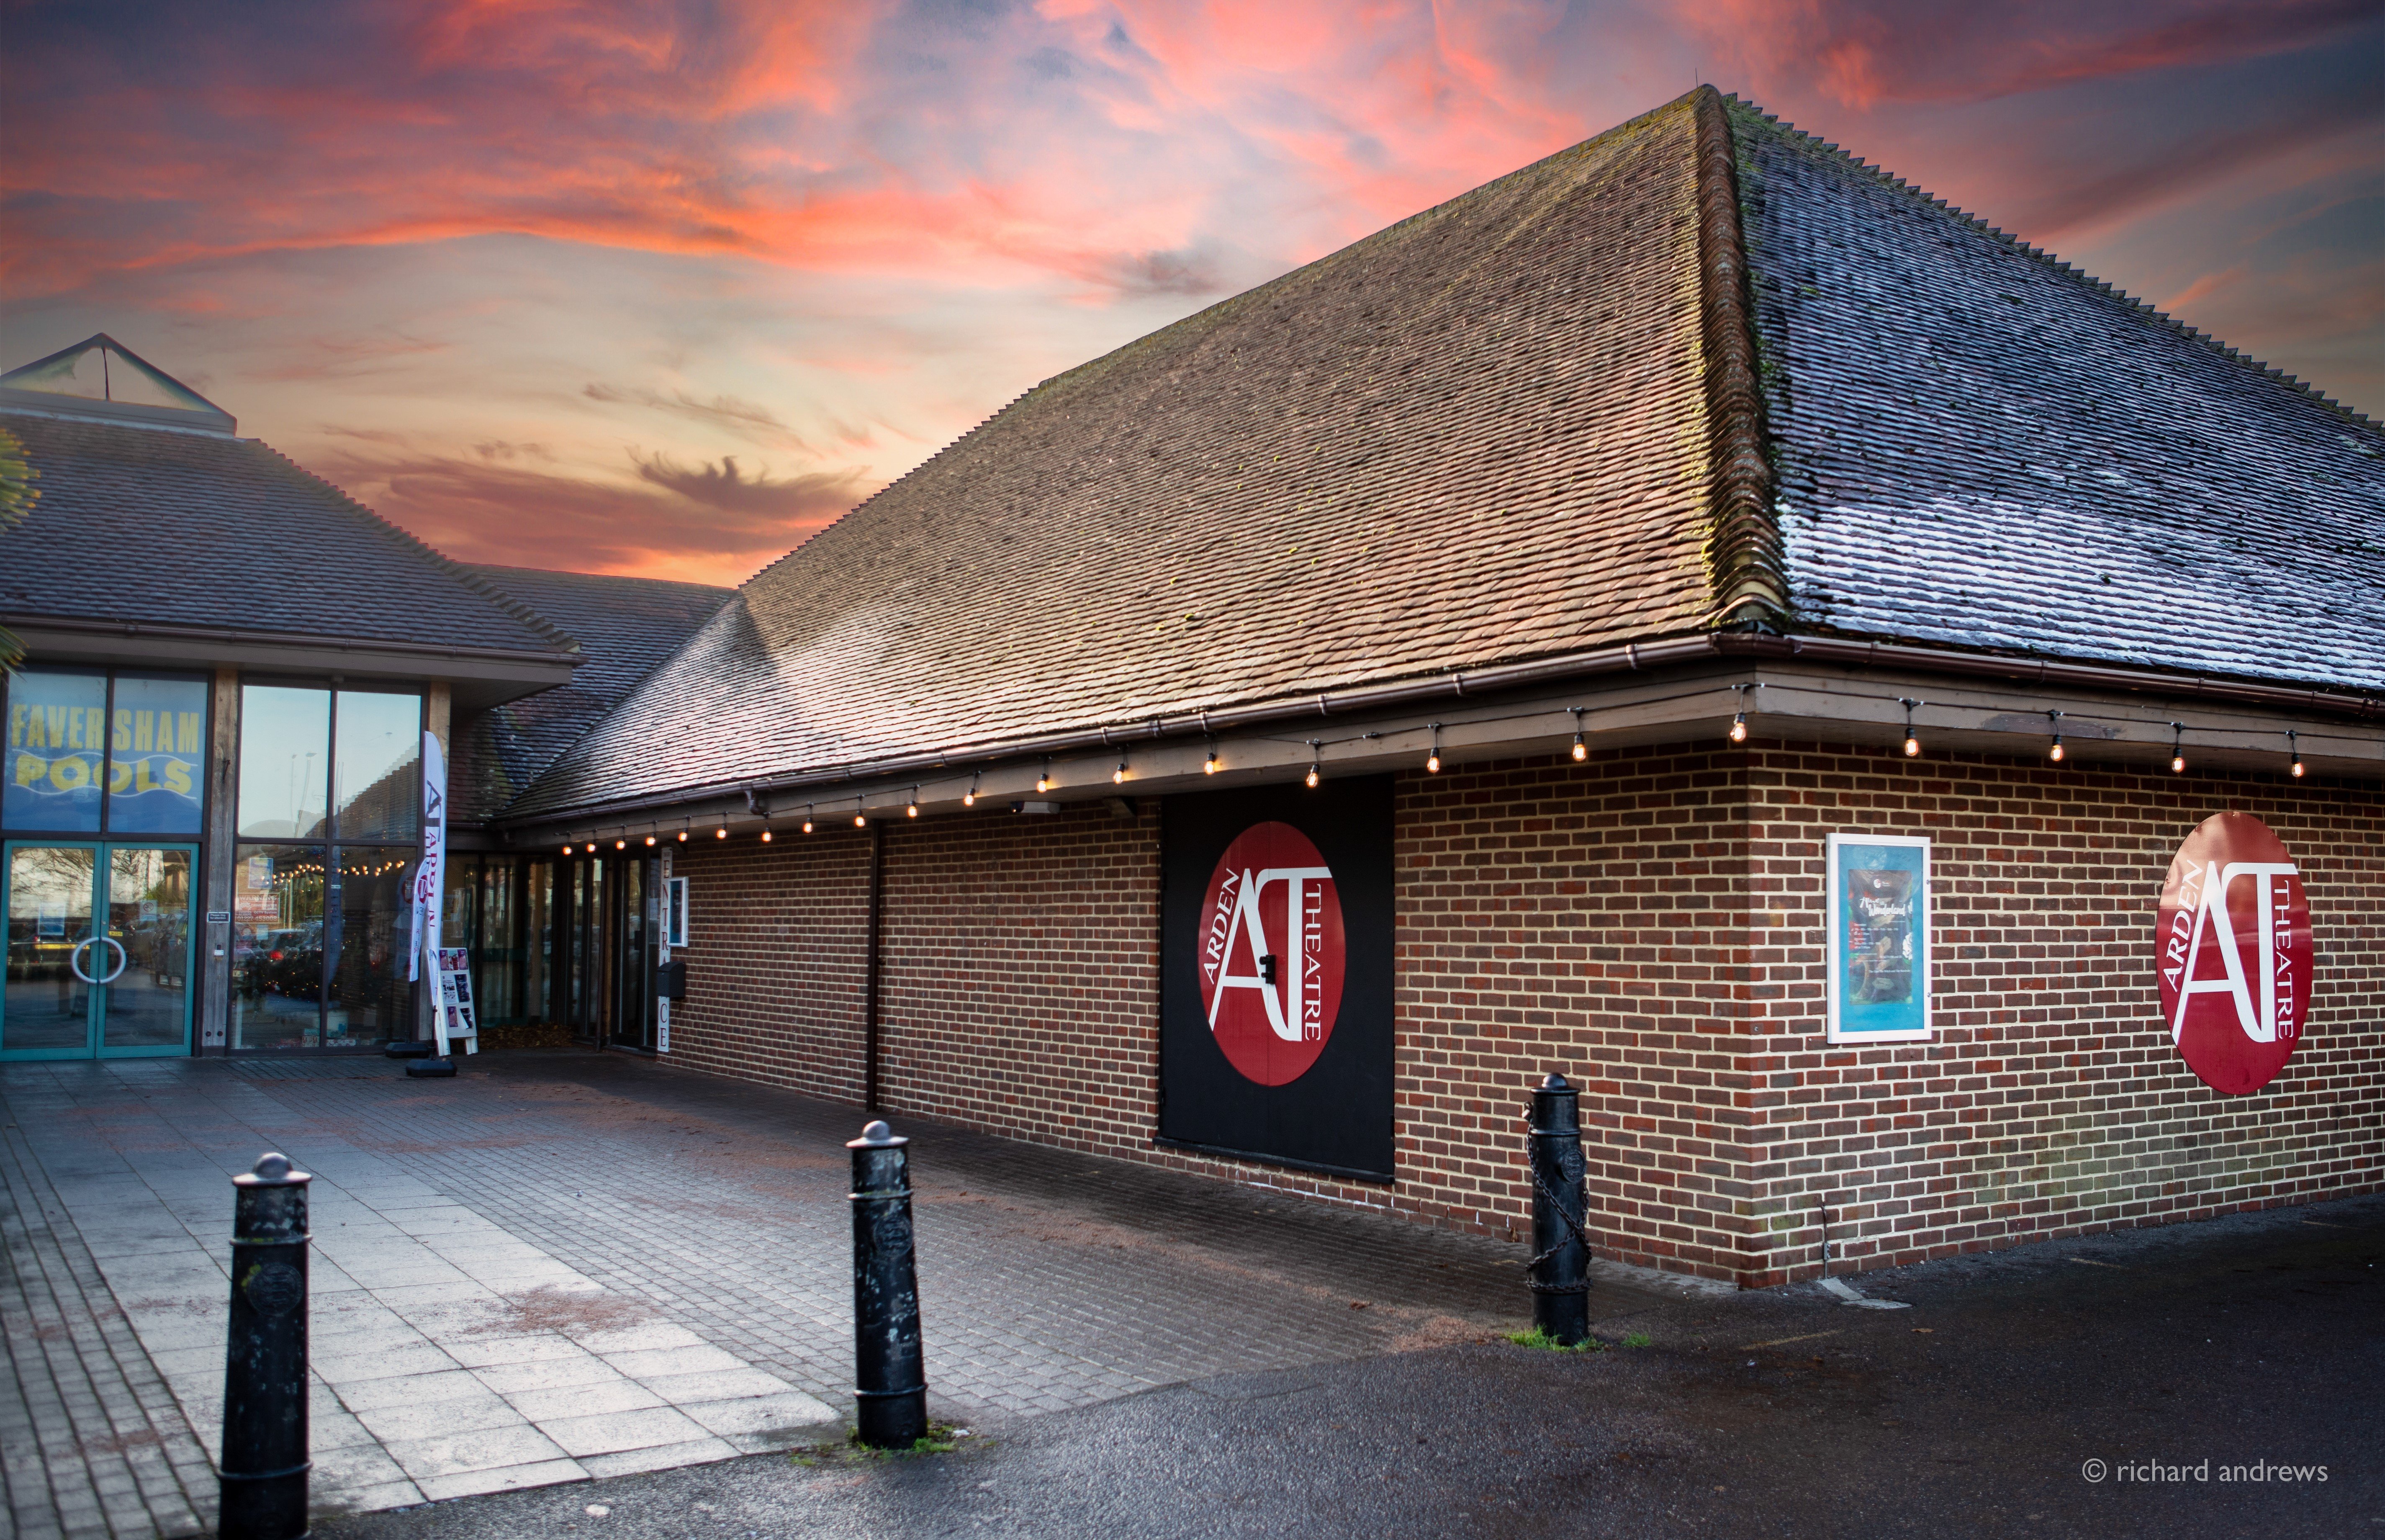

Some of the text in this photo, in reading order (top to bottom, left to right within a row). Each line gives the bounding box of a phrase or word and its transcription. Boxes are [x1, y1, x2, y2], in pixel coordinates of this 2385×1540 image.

[11, 704, 200, 753] FAVERSHAM
[15, 754, 192, 795] POOLS
[660, 860, 670, 1047] ENTRCE
[1203, 868, 1239, 985] ARDEN
[1305, 884, 1321, 1041] THEATRE
[1868, 903, 1906, 916] Wonderland
[2163, 859, 2203, 992] ARDEN
[2274, 880, 2293, 1039] THEATRE
